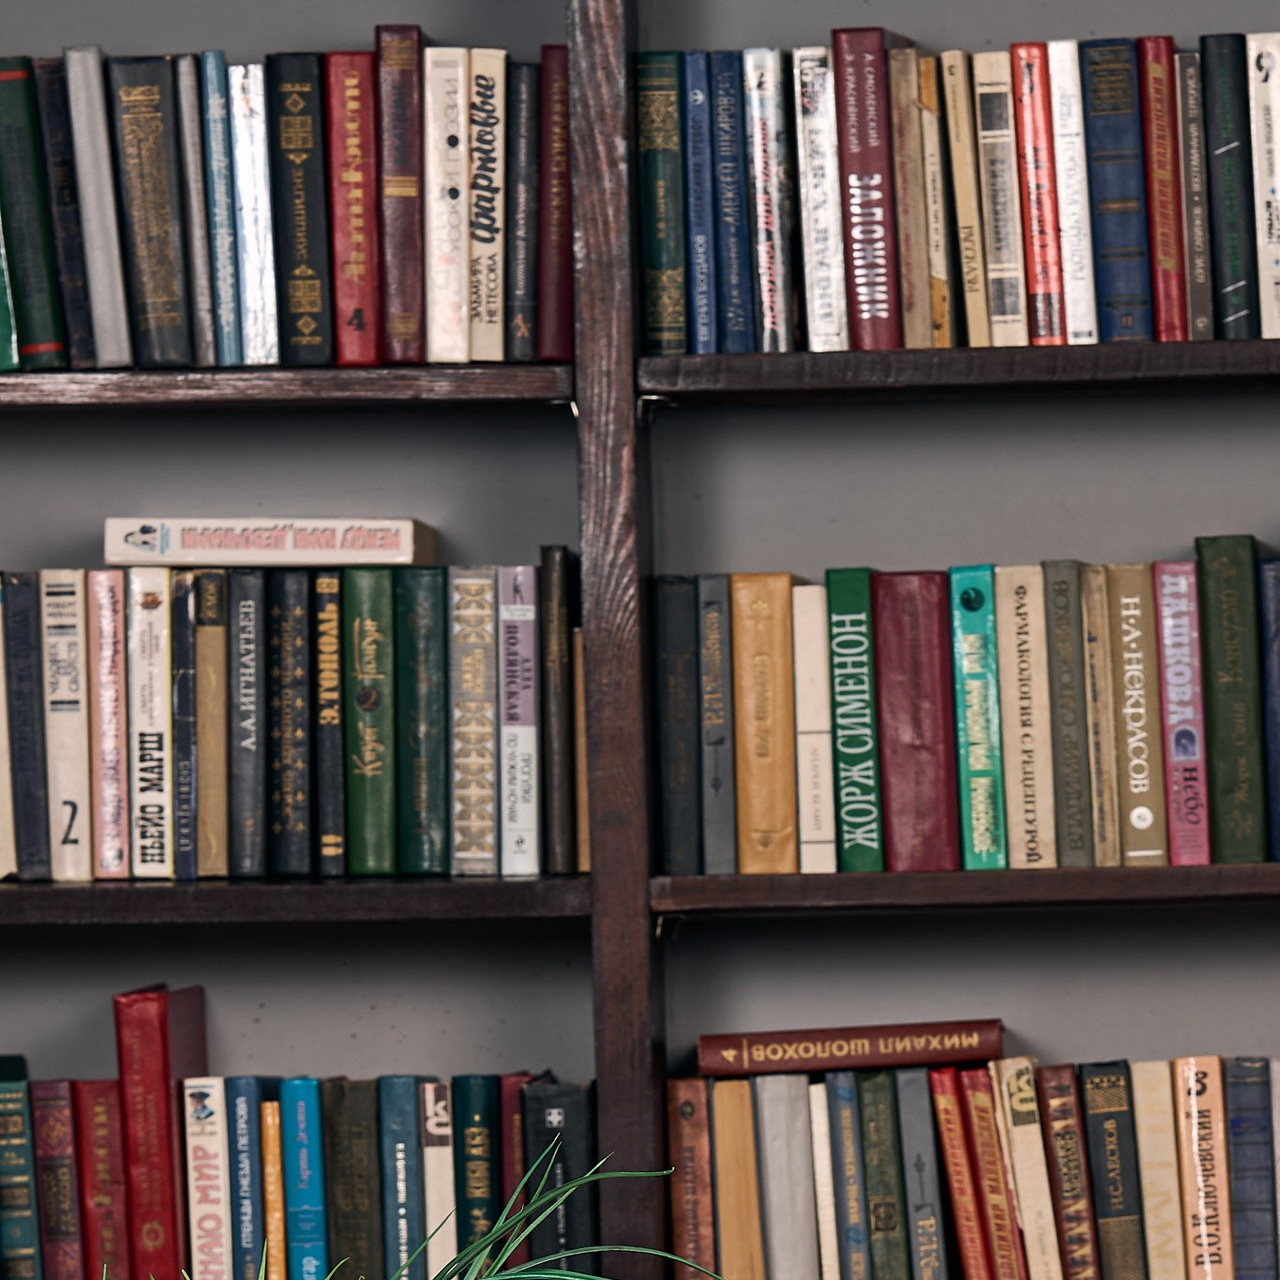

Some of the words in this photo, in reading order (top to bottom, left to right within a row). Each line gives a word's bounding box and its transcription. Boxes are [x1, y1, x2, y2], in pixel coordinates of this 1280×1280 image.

[696, 235, 709, 291] БОГДАНОВ
[849, 174, 889, 319] ЗАЛОЖНИК
[485, 253, 499, 324] НЕТЕСОВА
[697, 294, 710, 341] ЕВГЕНИЙ
[317, 603, 339, 724] Э.ТОПОЛЬ
[352, 617, 385, 680] Гамсун
[504, 624, 520, 722] ПОЛЯНСКАЯ
[1015, 586, 1032, 727] ФАРМАКОЛОГИЯ
[1053, 581, 1076, 726] САПОЖНИКОВ
[1161, 574, 1191, 724] ДАШКОВА
[831, 612, 873, 753] СИМЕНОН
[138, 731, 163, 792] МАРШ
[353, 721, 385, 776] Кнут
[1022, 734, 1032, 742] С
[60, 801, 78, 845] 2
[838, 760, 879, 849] ЖОРЖ
[1022, 749, 1042, 863] РЕЦЕПТУРОЙ
[1063, 734, 1085, 850] ВЛАДИМИР
[134, 805, 165, 863] НЬЕЙО
[752, 1039, 870, 1062] ШОЛОХОВ
[879, 1032, 979, 1053] МИХАИЛ
[235, 1096, 249, 1150] ПЕТРОВА
[193, 1145, 220, 1204] МИР
